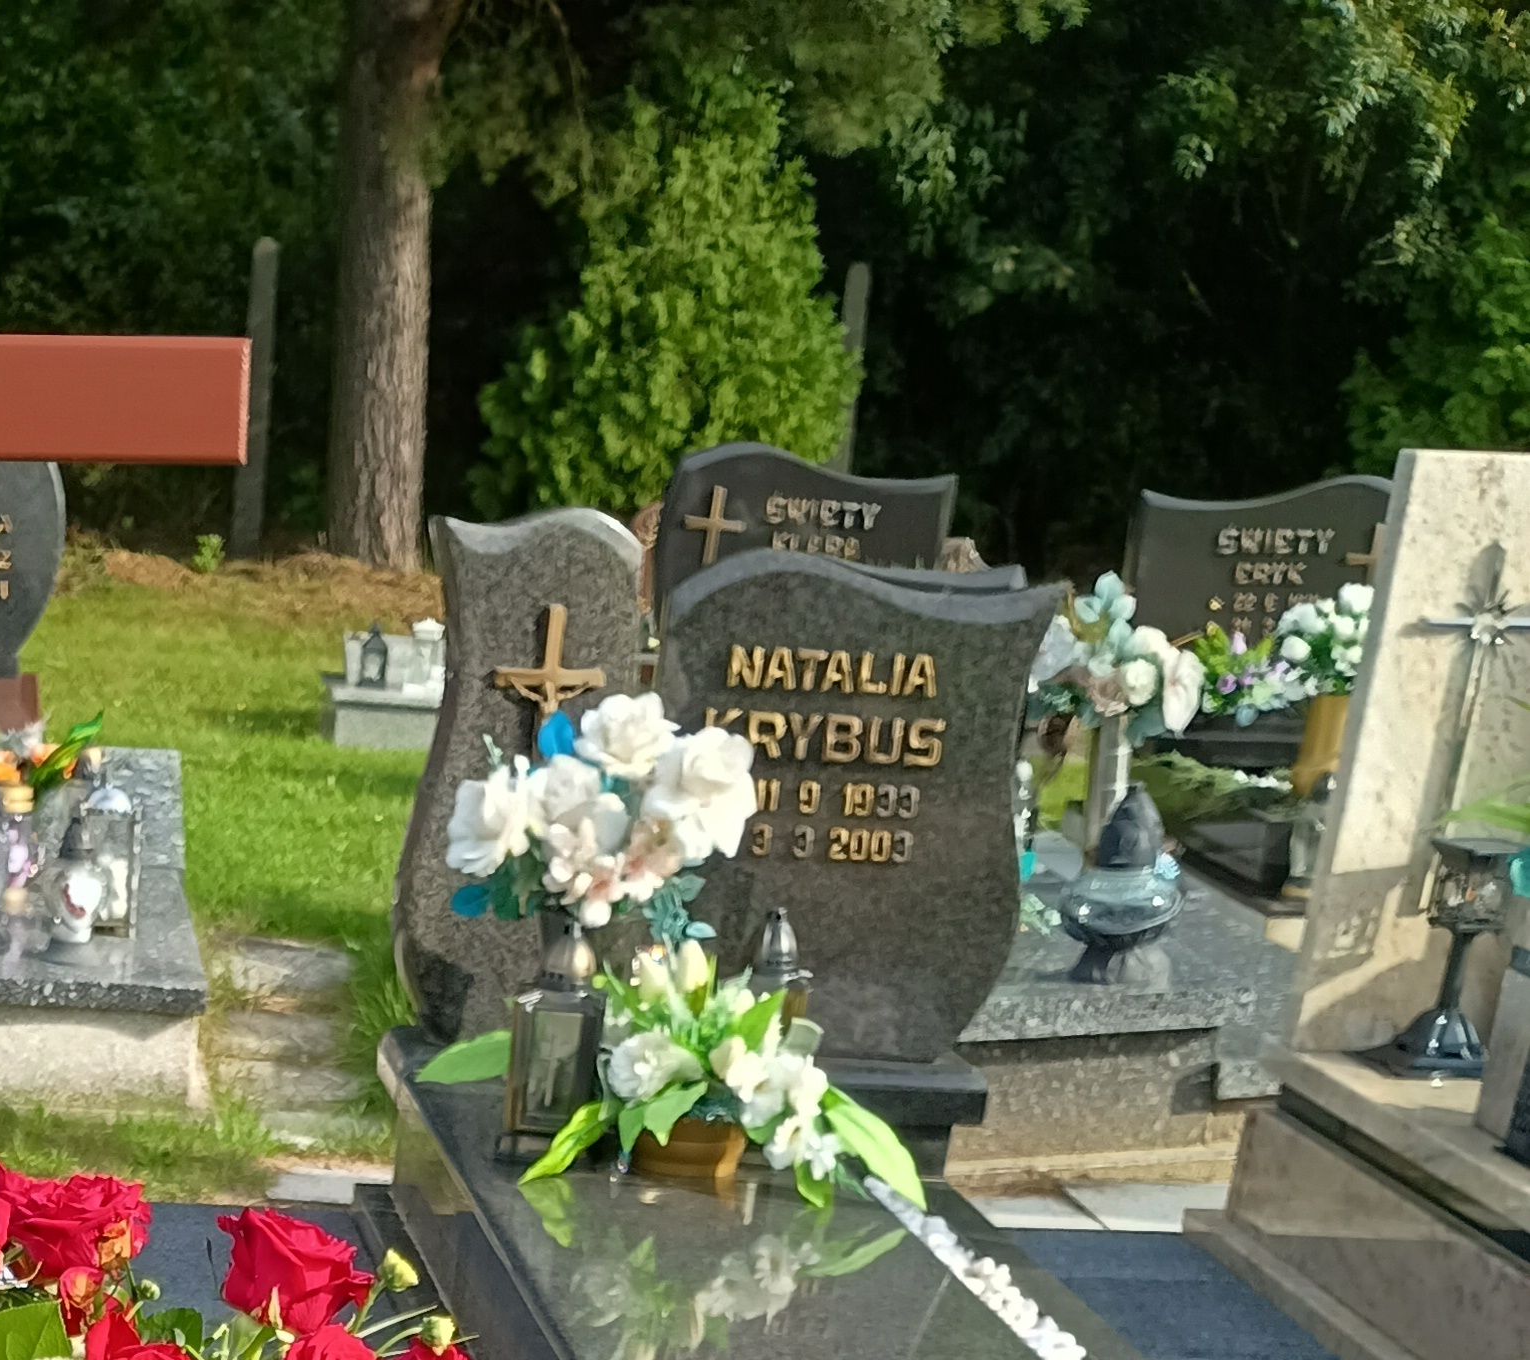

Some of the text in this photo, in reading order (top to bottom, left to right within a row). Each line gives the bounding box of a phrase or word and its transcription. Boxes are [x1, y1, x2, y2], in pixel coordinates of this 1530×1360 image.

[726, 643, 938, 699] NATALIA
[843, 782, 921, 819] 1933
[828, 826, 915, 864] 2003
